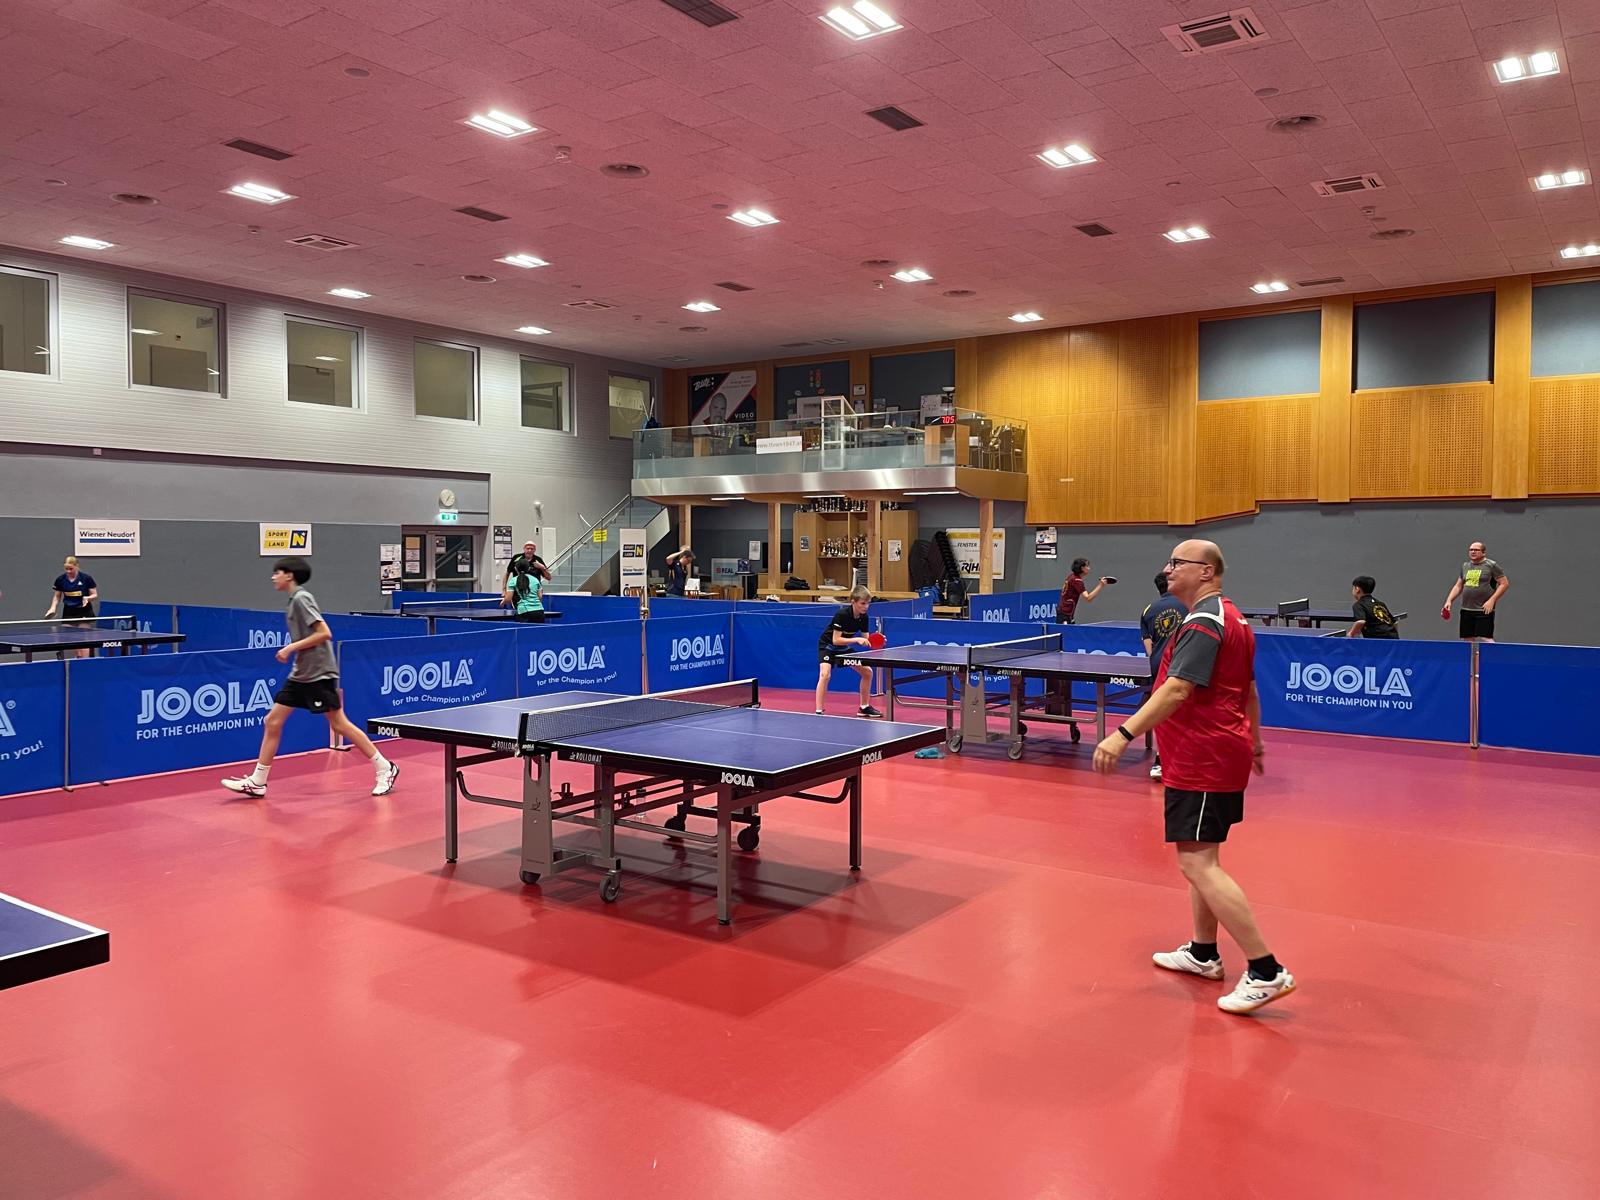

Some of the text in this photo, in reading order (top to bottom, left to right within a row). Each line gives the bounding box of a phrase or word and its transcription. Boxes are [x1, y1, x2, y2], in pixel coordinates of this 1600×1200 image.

[669, 658, 725, 672] FOR THE CHAMPION IN YOU
[537, 679, 547, 687] for
[548, 676, 560, 684] the
[561, 676, 595, 686] Champion
[1110, 677, 1134, 685] JOOLA
[393, 698, 404, 706] for
[406, 695, 419, 703] the
[421, 695, 461, 704] Champion
[471, 687, 488, 701] you!
[1285, 692, 1413, 710] FOR THE CHAMPION IN YOU
[136, 728, 159, 740] FOR
[162, 725, 183, 737] THE
[185, 718, 242, 734] CHAMPION
[244, 717, 255, 727] IN
[378, 726, 400, 737] JOOLA
[14, 740, 44, 760] you!
[862, 751, 883, 765] JOOLA
[721, 772, 755, 787] JOOLA
